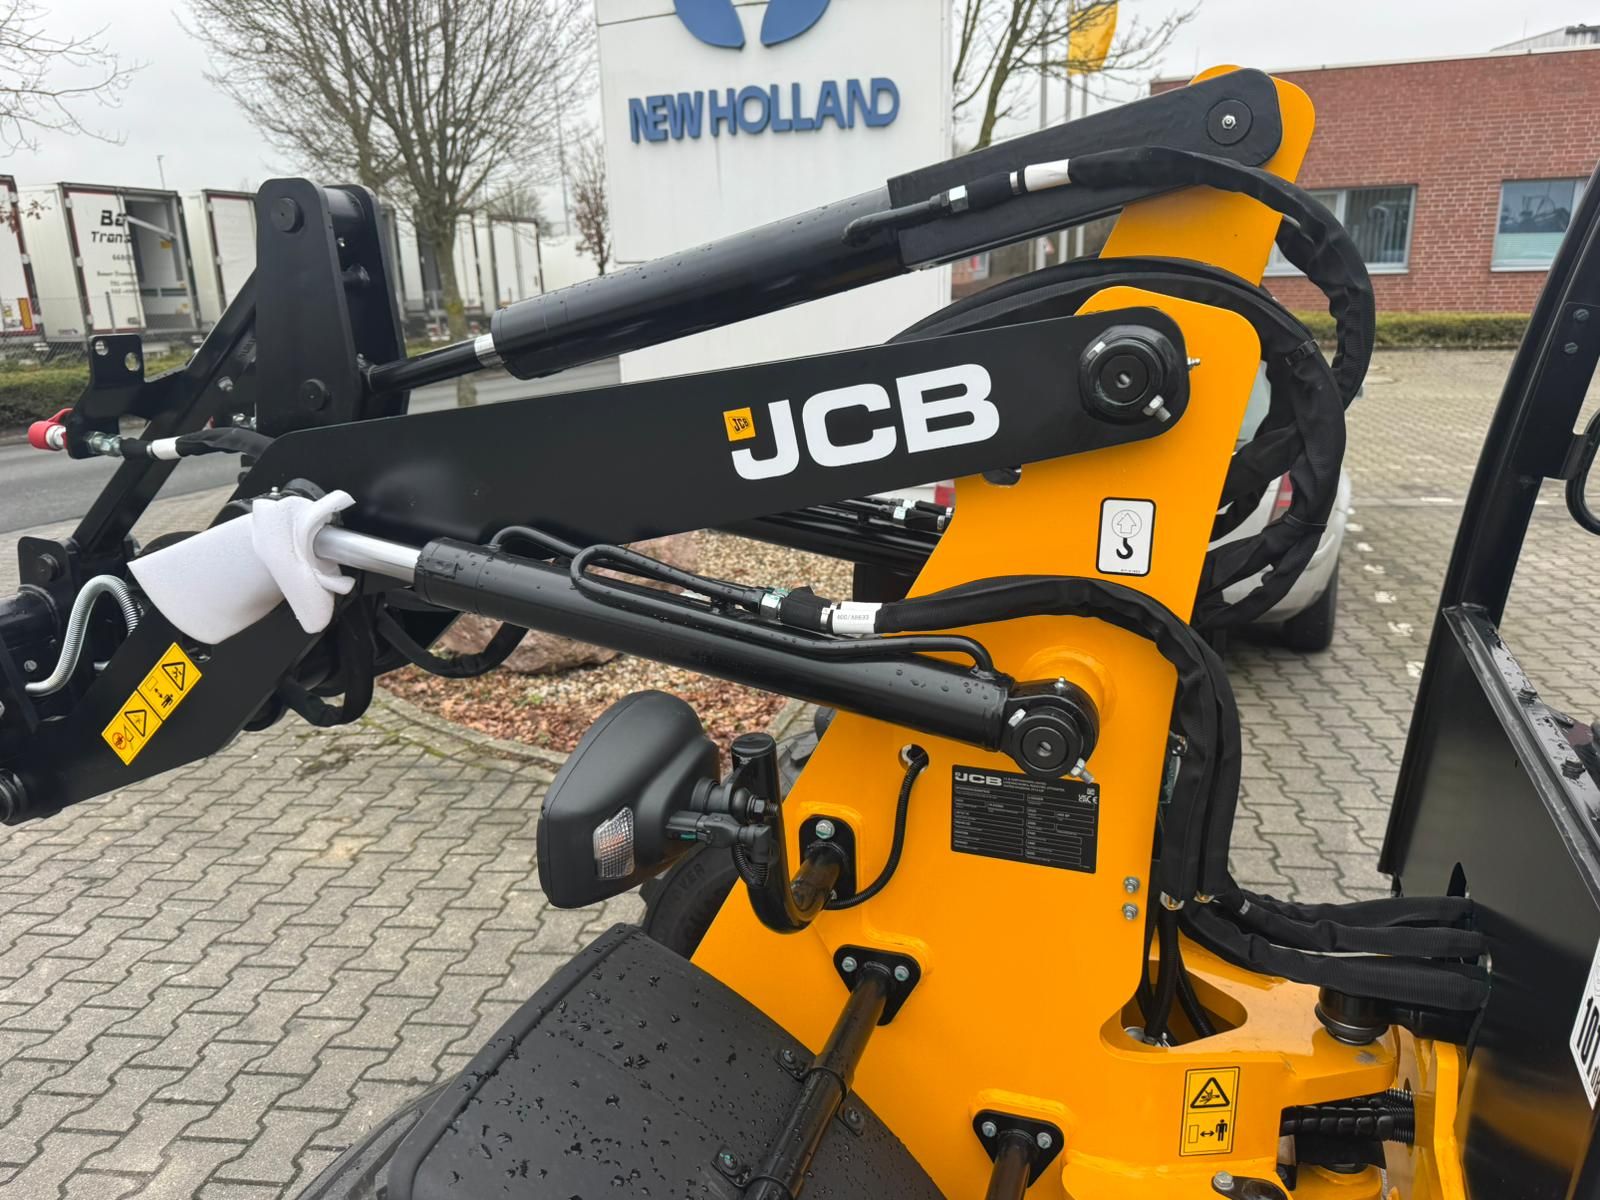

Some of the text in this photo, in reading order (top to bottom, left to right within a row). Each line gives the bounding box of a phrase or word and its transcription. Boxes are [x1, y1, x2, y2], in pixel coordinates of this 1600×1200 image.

[628, 77, 901, 144] NEW HOLLAND
[731, 363, 1000, 480] JCB
[732, 417, 749, 432] JCB
[954, 772, 1002, 786] JCB
